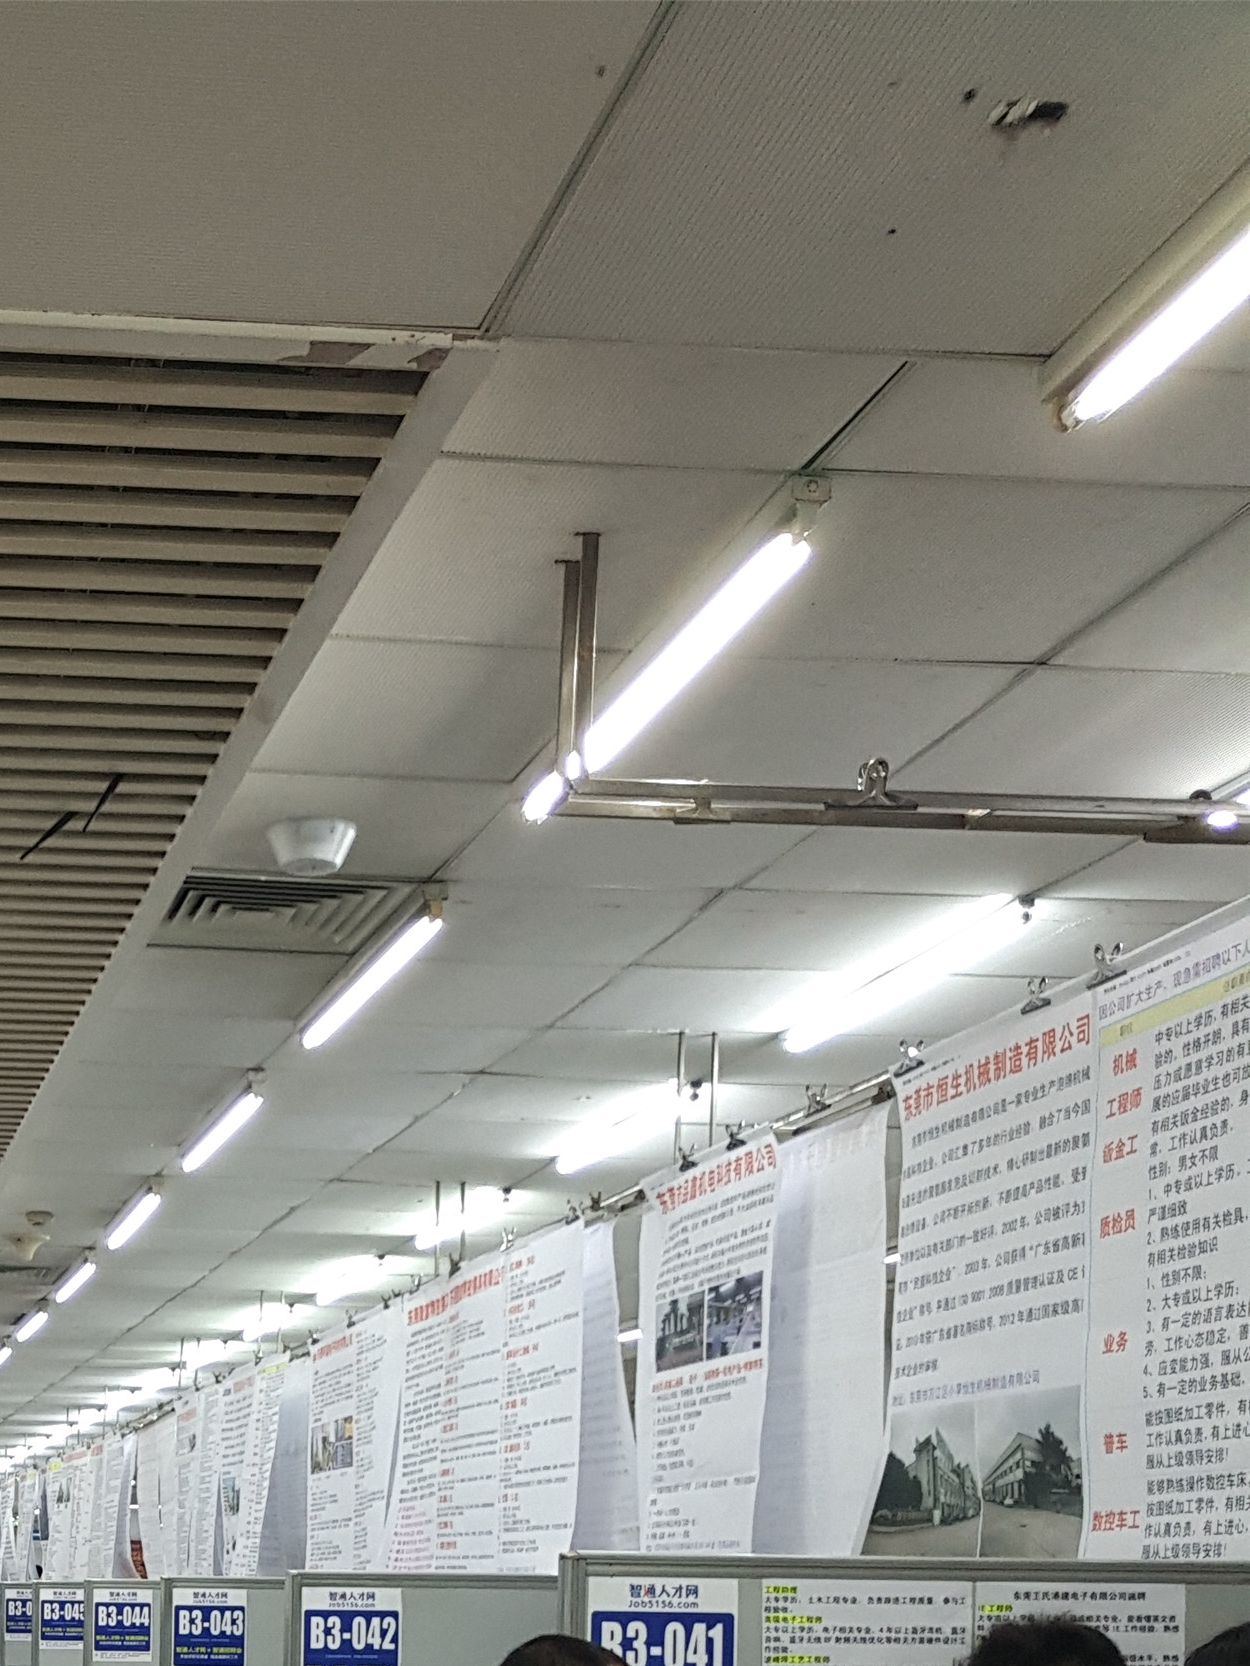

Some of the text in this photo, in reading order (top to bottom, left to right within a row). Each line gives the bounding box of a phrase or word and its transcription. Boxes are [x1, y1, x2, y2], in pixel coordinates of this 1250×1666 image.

[903, 1013, 1091, 1122] 东莞市恒生机械制造有限公司
[1112, 1048, 1138, 1076] 机械
[1105, 1087, 1143, 1119] 工程师
[1103, 1134, 1139, 1164] 钣金工
[1100, 1208, 1135, 1239] 质检员
[1147, 1200, 1187, 1224] 严谨细致
[1145, 1301, 1250, 1334] 3、有一定的语言表达
[1102, 1331, 1128, 1354] 业务
[1103, 1432, 1129, 1454] 普车
[1091, 1510, 1141, 1532] 数控车工
[329, 1592, 376, 1601] 智通人才网
[629, 1584, 699, 1599] 智通人才网
[98, 1606, 150, 1628] B3-044
[628, 1600, 699, 1609] Job5156.com
[178, 1609, 245, 1636] B3-043
[309, 1616, 396, 1651] B3-042
